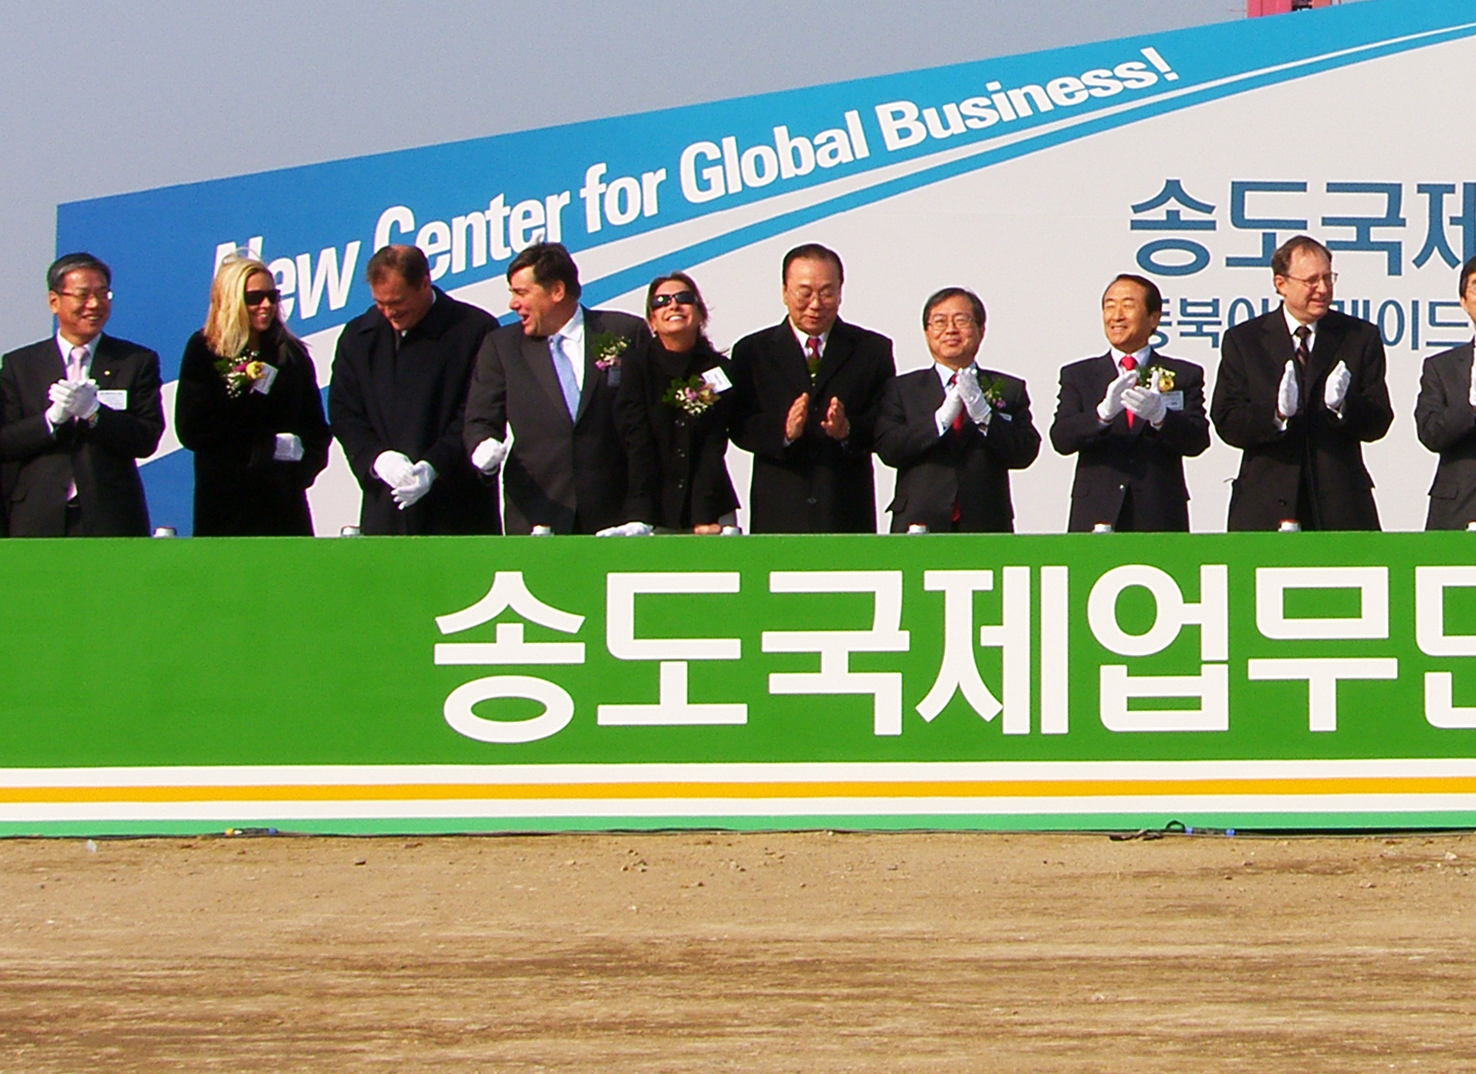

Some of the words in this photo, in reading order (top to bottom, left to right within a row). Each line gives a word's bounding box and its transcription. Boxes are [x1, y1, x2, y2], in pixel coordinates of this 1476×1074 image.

[580, 162, 667, 233] for
[679, 109, 870, 205] Global
[875, 46, 1180, 152] Business!
